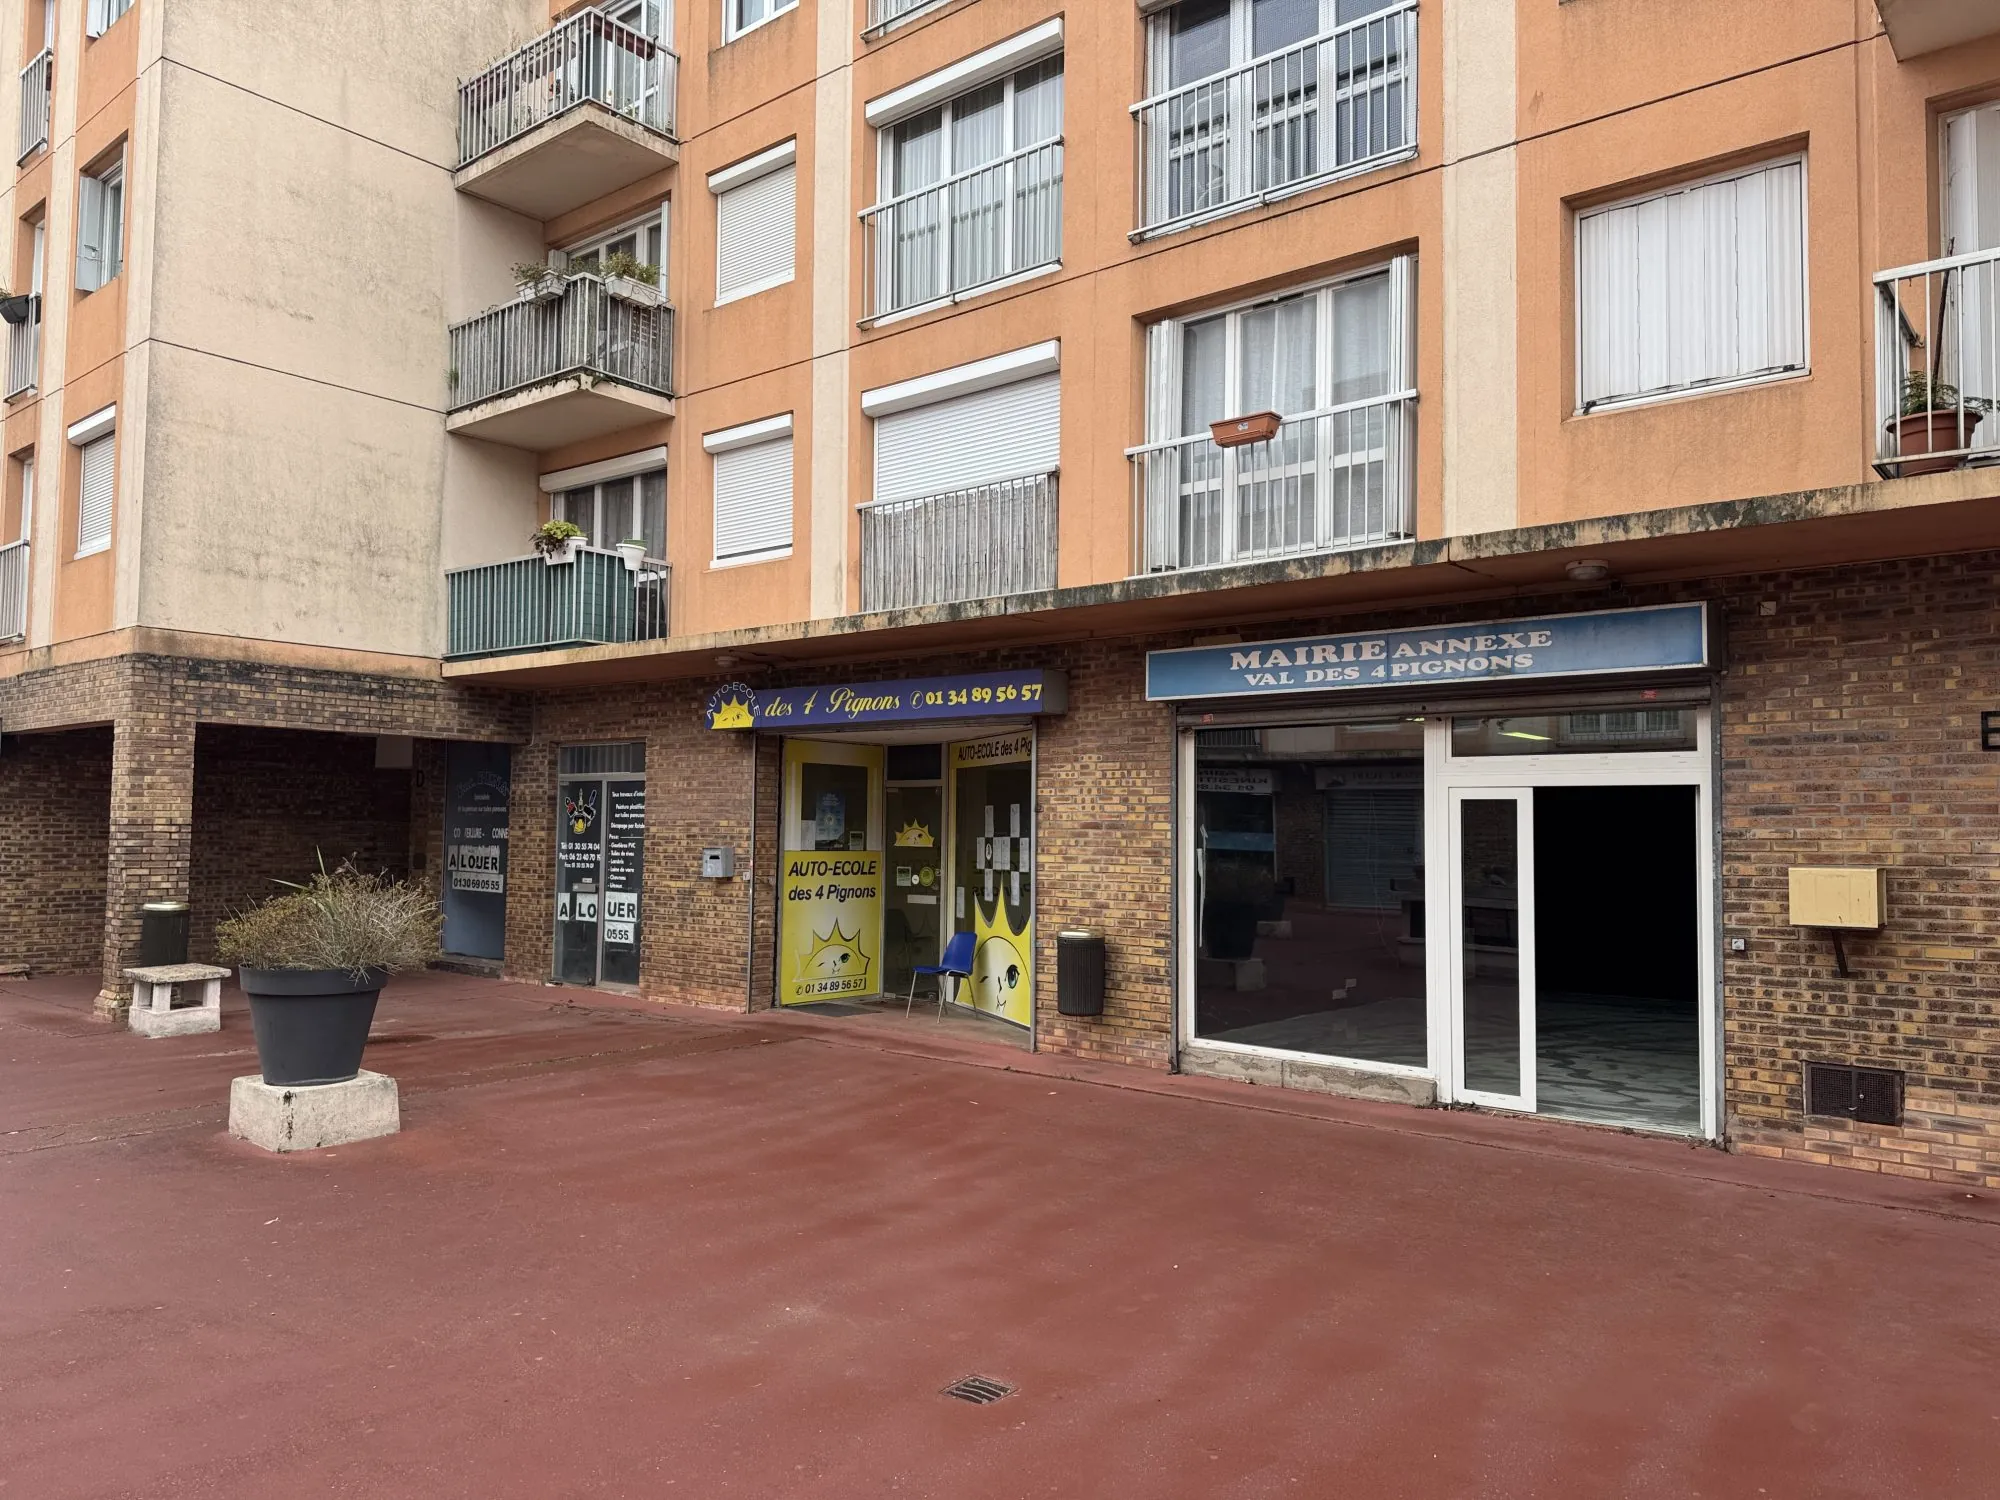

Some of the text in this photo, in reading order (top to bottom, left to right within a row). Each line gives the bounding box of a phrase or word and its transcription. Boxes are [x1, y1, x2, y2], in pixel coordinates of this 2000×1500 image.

[1229, 630, 1553, 671] MAIRIE ANNEXE
[1243, 653, 1534, 687] VAL DES 4 PIGNONS
[706, 682, 761, 720] AUTO-ECOLE
[764, 683, 1043, 720] des 4 Pignons 01 34 89 56 57
[958, 741, 999, 760] AUTO-ECOLE
[1000, 740, 1013, 756] des
[1014, 738, 1019, 755] 4
[449, 853, 498, 871] A LOUER
[788, 861, 877, 877] AUTO-ECOLE
[788, 884, 877, 903] des 4 Pignons
[559, 902, 568, 917] A
[805, 978, 863, 994] 01 34 89 56 57
